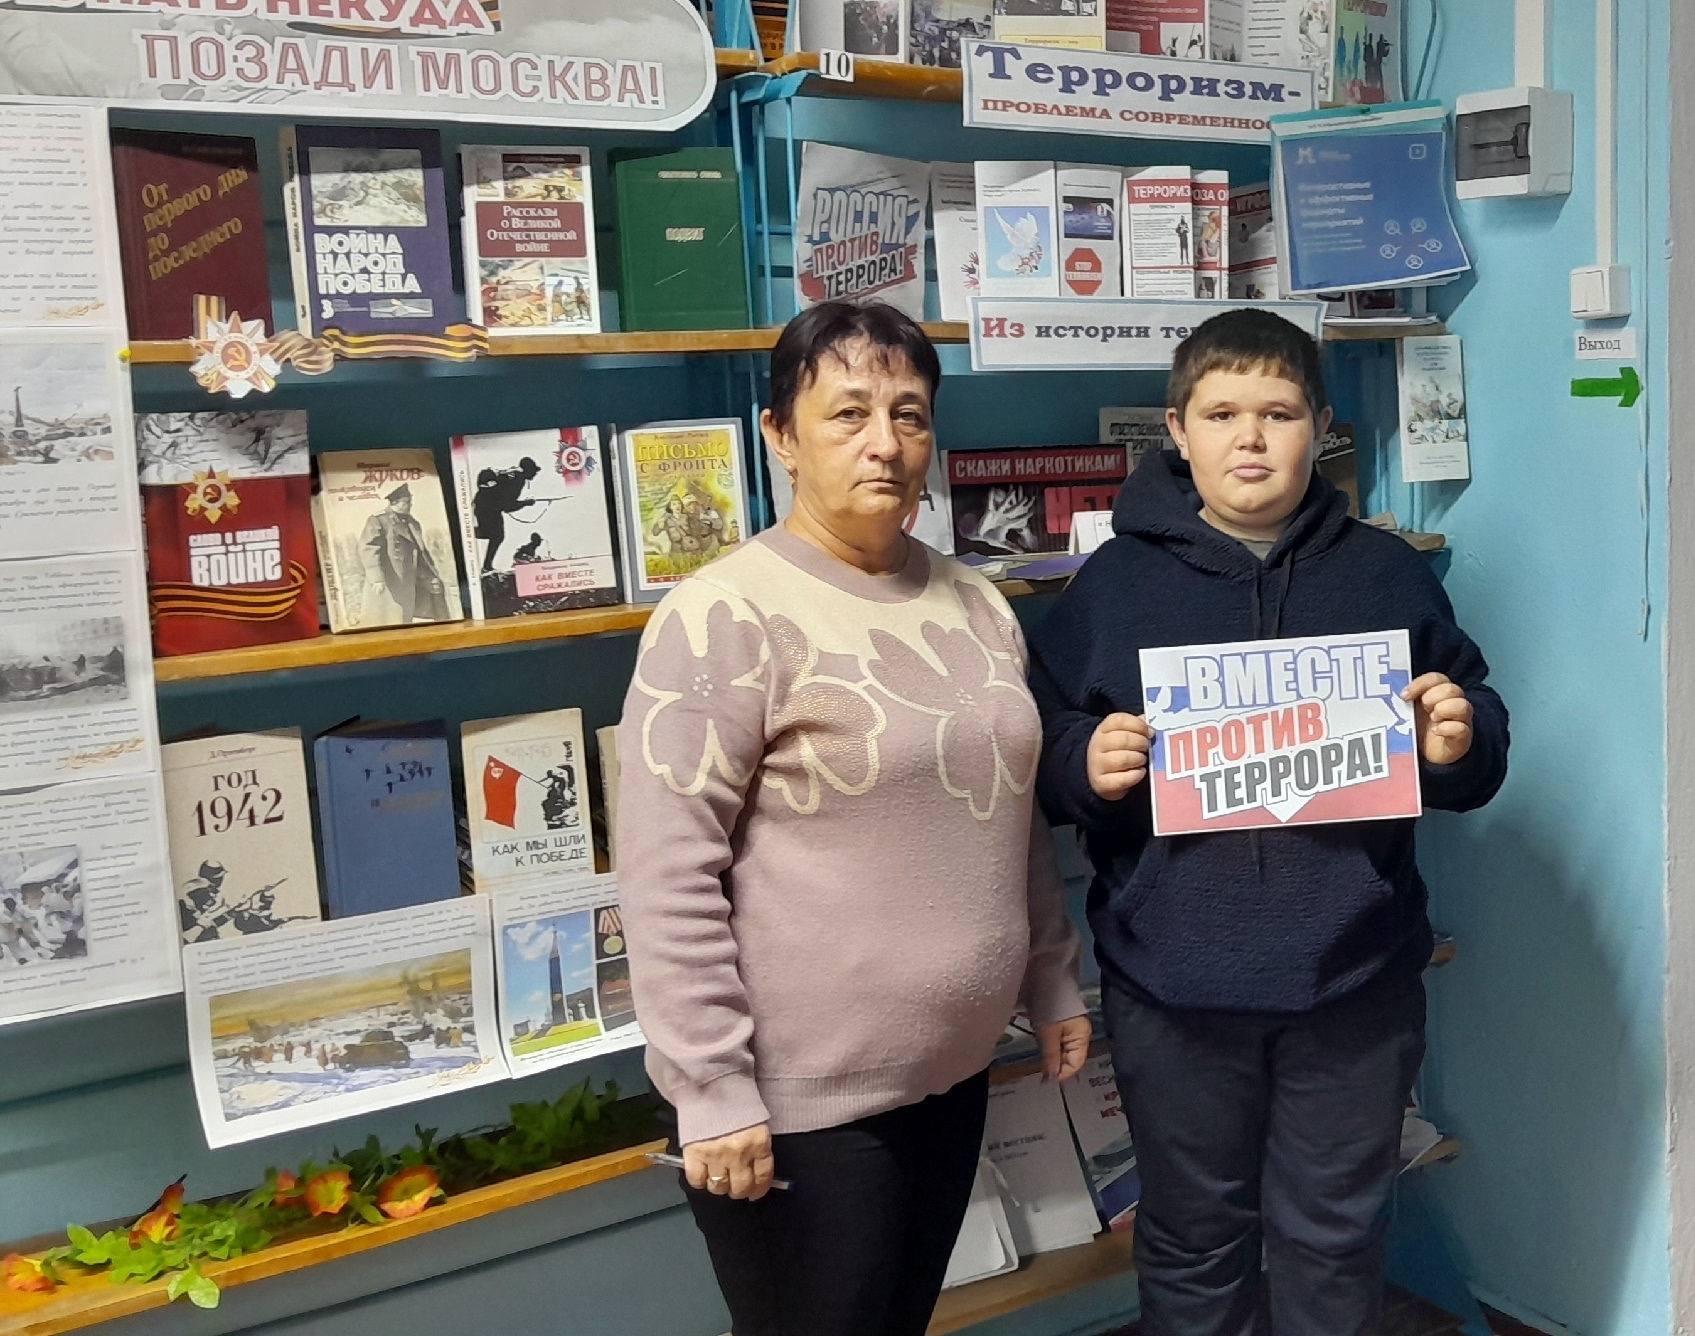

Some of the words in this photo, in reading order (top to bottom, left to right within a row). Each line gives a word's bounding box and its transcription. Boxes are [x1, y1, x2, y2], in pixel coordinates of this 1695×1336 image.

[140, 34, 394, 92] ПОЗАДИ
[416, 51, 661, 105] МОСКВА!
[822, 52, 851, 78] 10
[974, 44, 1302, 102] Терроризм-
[981, 98, 1112, 119] ПРОБЛЕМА
[141, 183, 169, 208] От
[1132, 185, 1192, 198] ТЕРРОРИЗ
[143, 184, 212, 232] первого
[812, 188, 908, 243] РОССИЯ
[314, 230, 404, 254] ВОЙНА
[813, 232, 880, 275] ПРОТИВ
[316, 253, 406, 275] НАРОД
[826, 249, 904, 299] ТЕРРОРА!
[318, 273, 423, 294] ПОБЕДА
[981, 317, 1026, 338] Из
[1035, 325, 1151, 343] истории
[1159, 326, 1201, 339] те
[1577, 336, 1622, 352] Выход
[637, 442, 730, 461] ПИСЬМО
[361, 467, 425, 489] ЖУКОВ
[640, 462, 650, 474] С
[658, 458, 729, 474] ФРОНТА
[955, 458, 1011, 478] СКАЖИ
[1014, 454, 1121, 477] НАРКОТИКАМ!
[534, 573, 554, 583] КАК
[557, 569, 596, 580] ВМЕСТЕ
[1184, 641, 1391, 712] ВМЕСТЕ
[1168, 702, 1325, 775] ПРОТИВ
[212, 769, 260, 792] год
[1200, 733, 1384, 813] ТЕРРОРА!
[191, 788, 285, 838] 1942
[491, 842, 519, 857] КАК
[526, 839, 548, 852] МЫ
[553, 833, 586, 849] ШЛИ
[515, 855, 526, 867] К
[530, 847, 588, 865] ПОБЕДЕ
